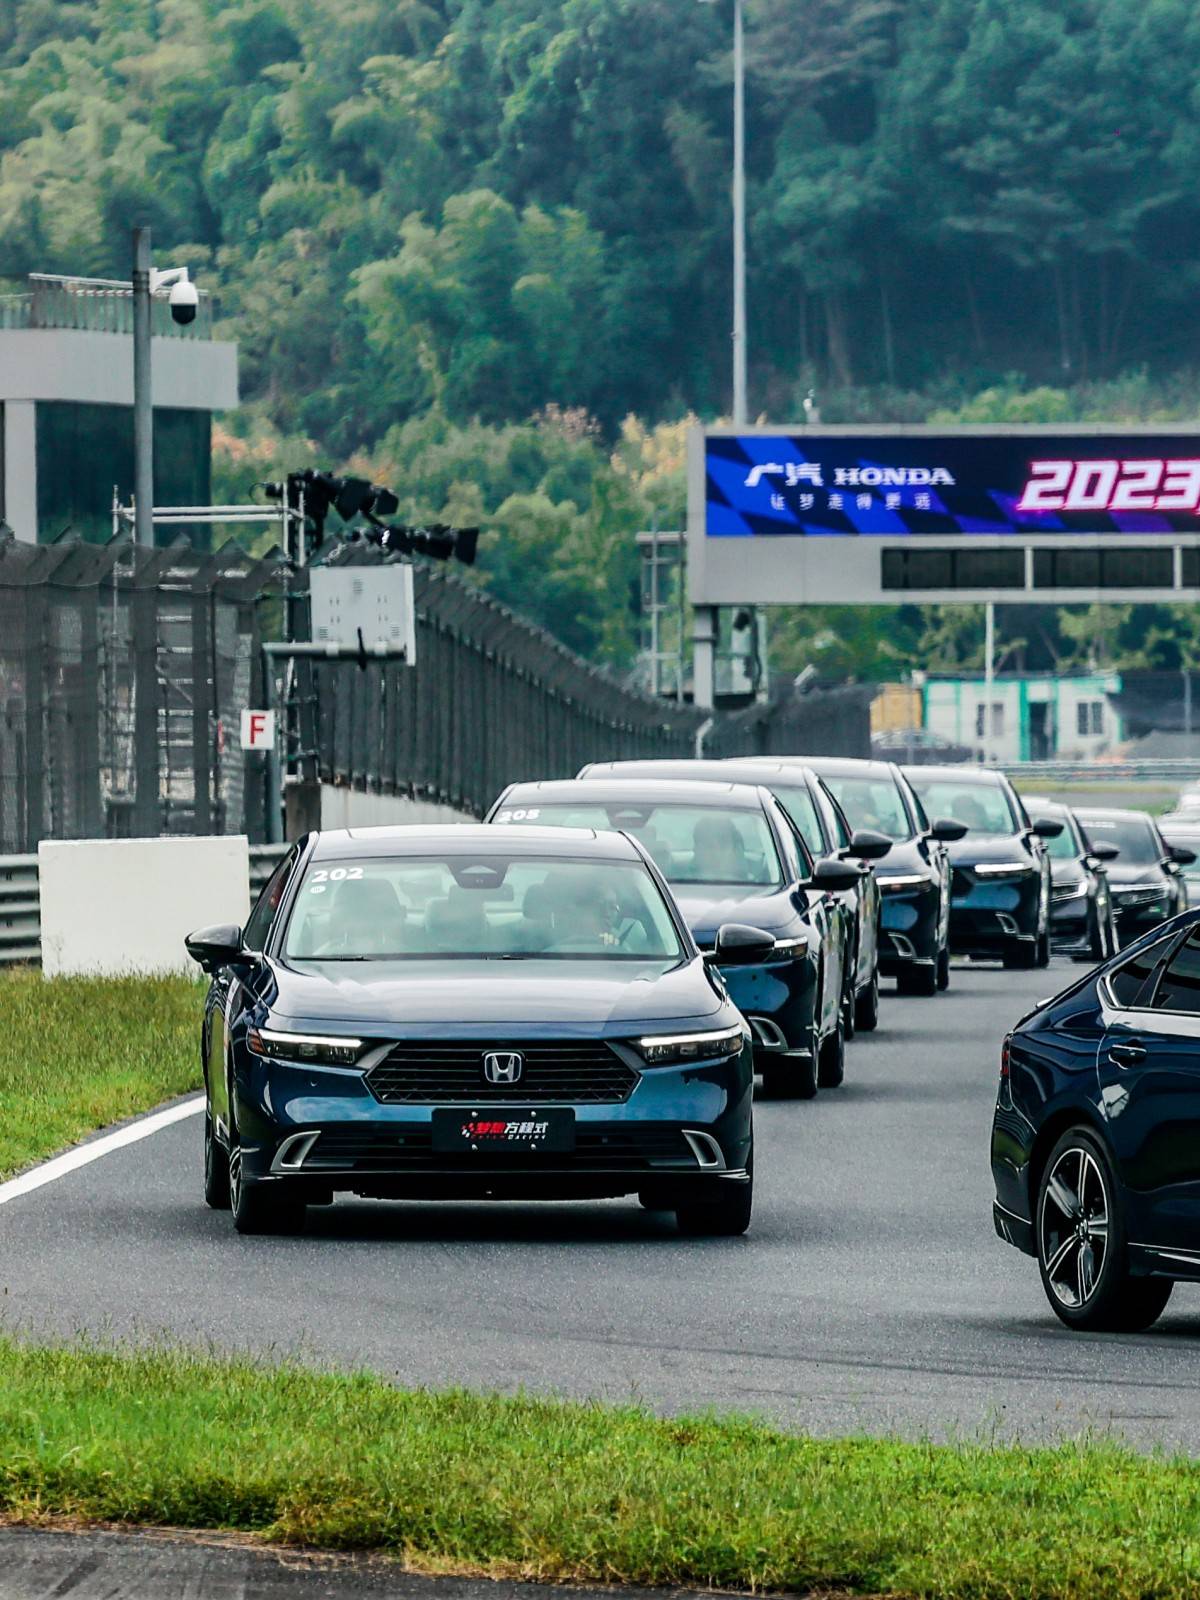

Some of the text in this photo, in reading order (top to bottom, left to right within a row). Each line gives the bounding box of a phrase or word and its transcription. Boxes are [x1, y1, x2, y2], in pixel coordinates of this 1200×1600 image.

[744, 462, 957, 487] 广汽 HONDA
[250, 715, 266, 745] F
[311, 867, 364, 883] 202
